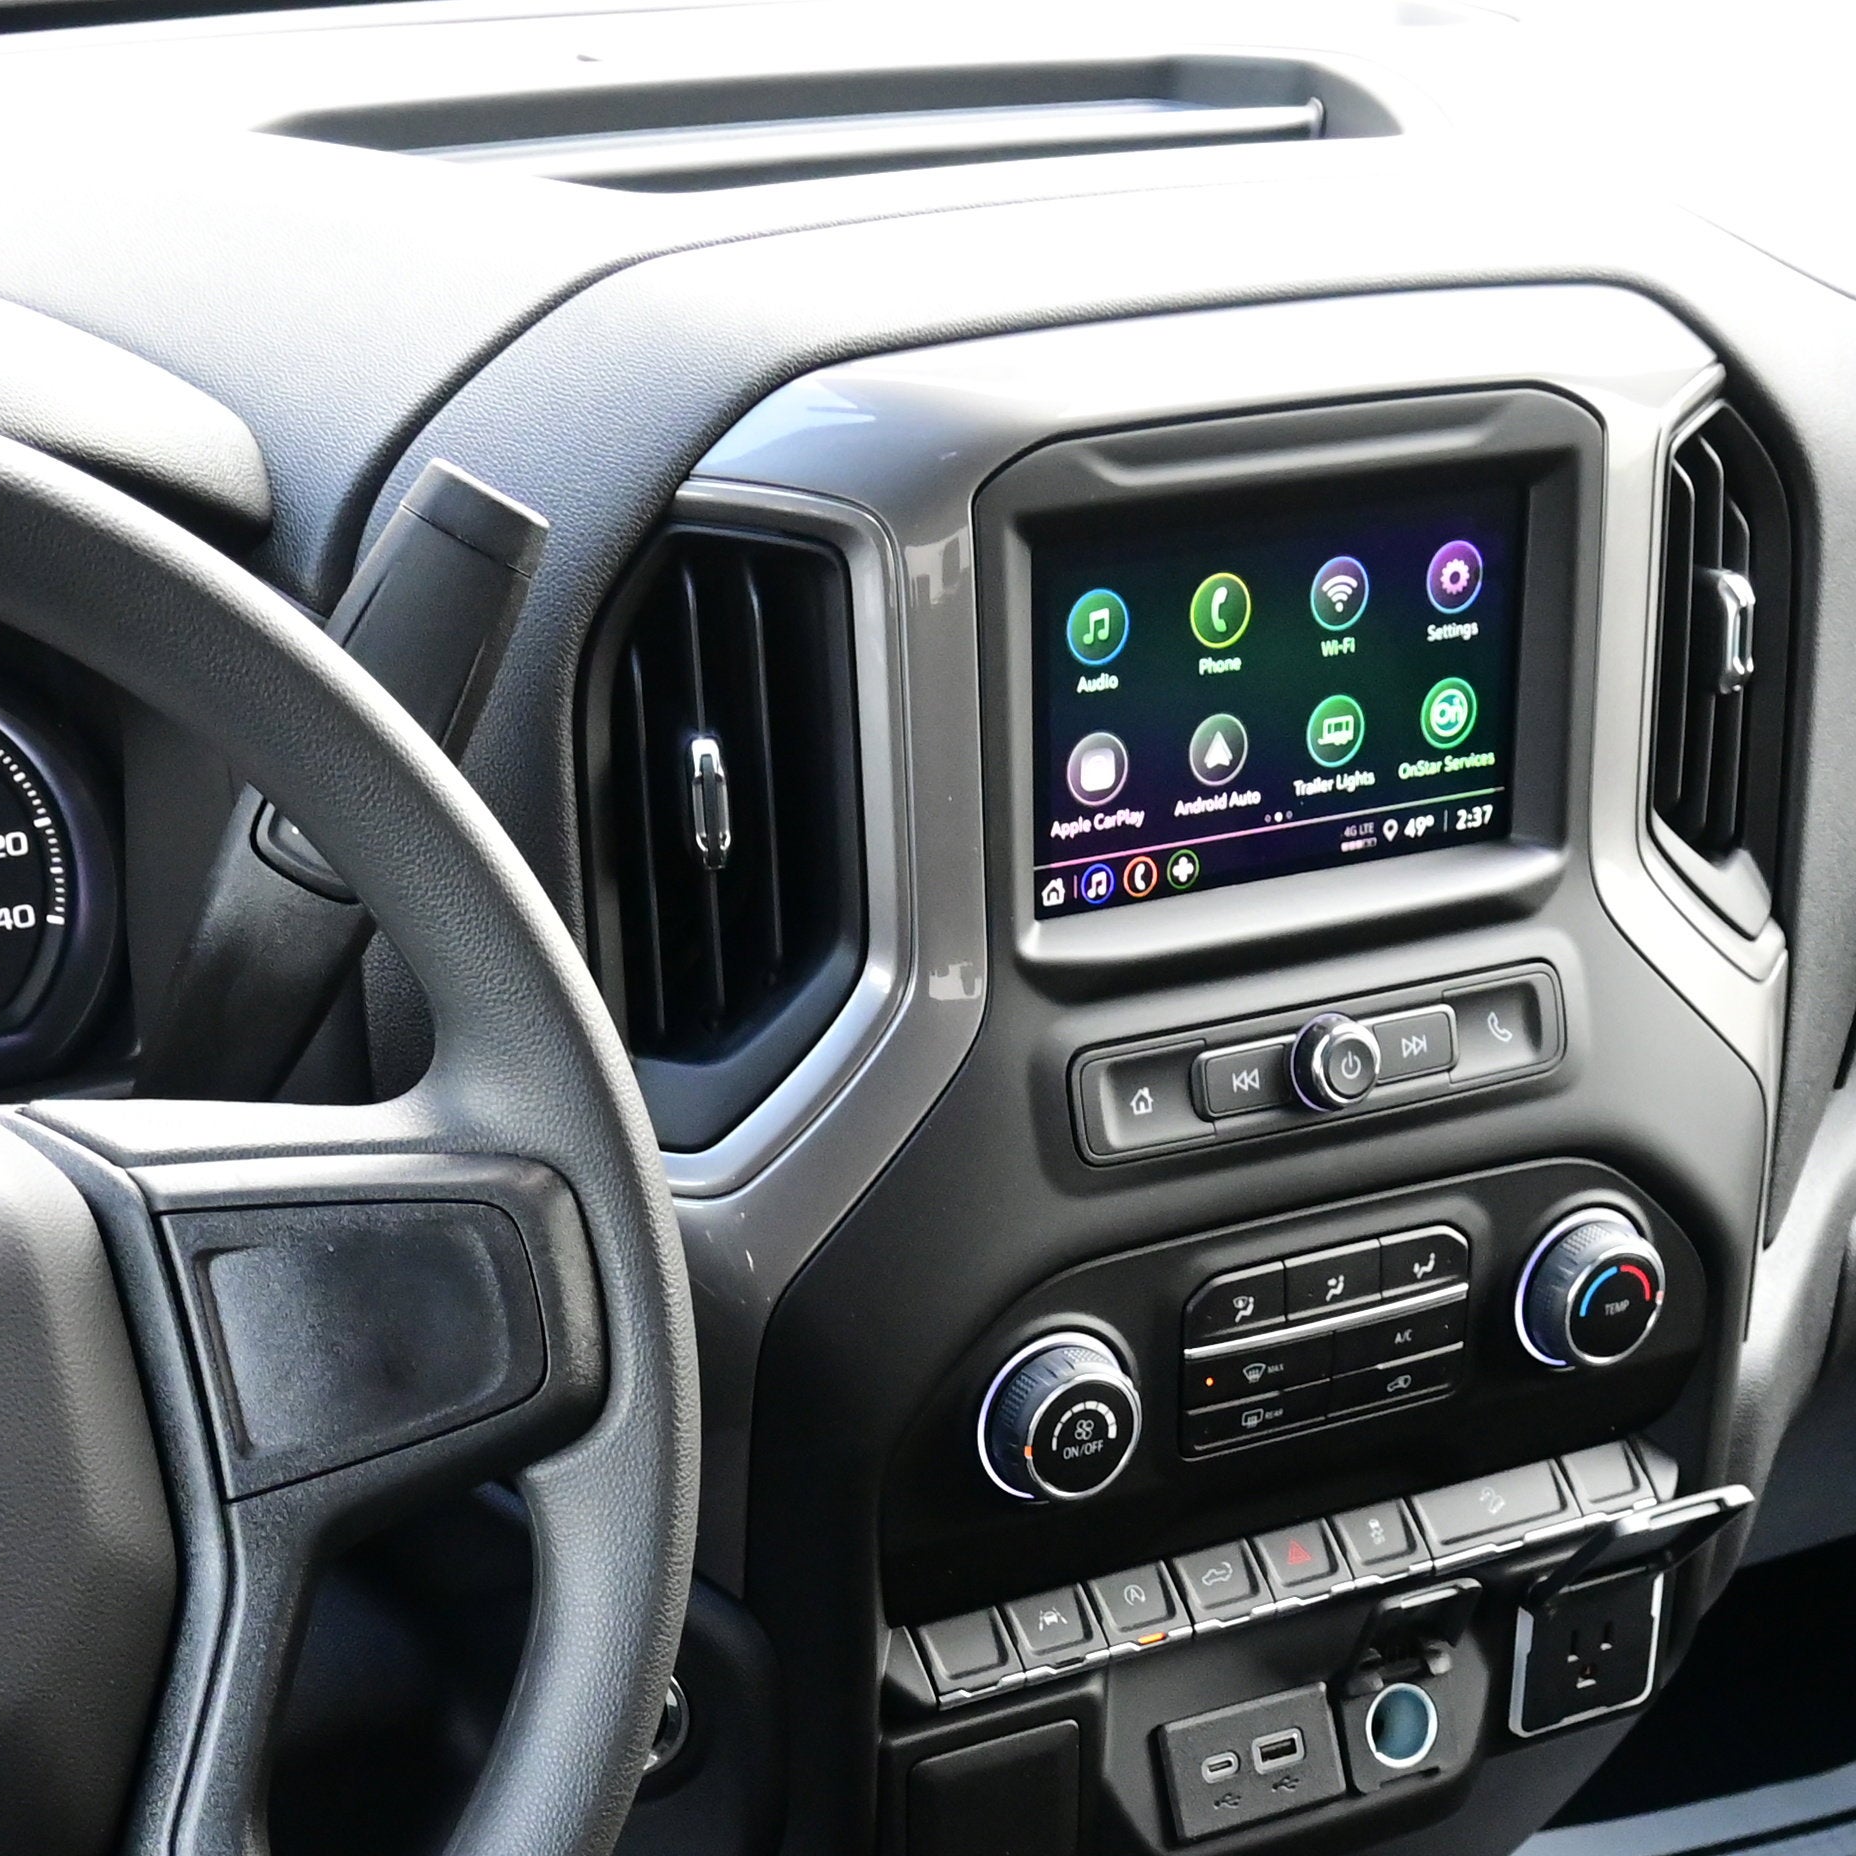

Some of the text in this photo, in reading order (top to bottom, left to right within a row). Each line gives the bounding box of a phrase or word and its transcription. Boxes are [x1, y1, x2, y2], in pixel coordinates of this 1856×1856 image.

[1426, 621, 1479, 642] Settings
[1320, 636, 1356, 657] Wi-Fi
[1198, 656, 1242, 676] Phone
[1076, 672, 1119, 694] Audio
[1398, 752, 1496, 780] OnStar Services
[1293, 770, 1376, 797] Trailer Lights
[1174, 789, 1262, 818] Android Auto
[1050, 808, 1145, 840] Apple CarPlay
[1455, 804, 1494, 831] 2:37
[1343, 821, 1375, 838] 4G LTE
[1604, 1298, 1631, 1317] TEMP
[1393, 1328, 1413, 1345] A/C
[1267, 1362, 1285, 1375] MAX
[1264, 1407, 1284, 1421] REAR
[1062, 1439, 1104, 1460] ON/OFF
